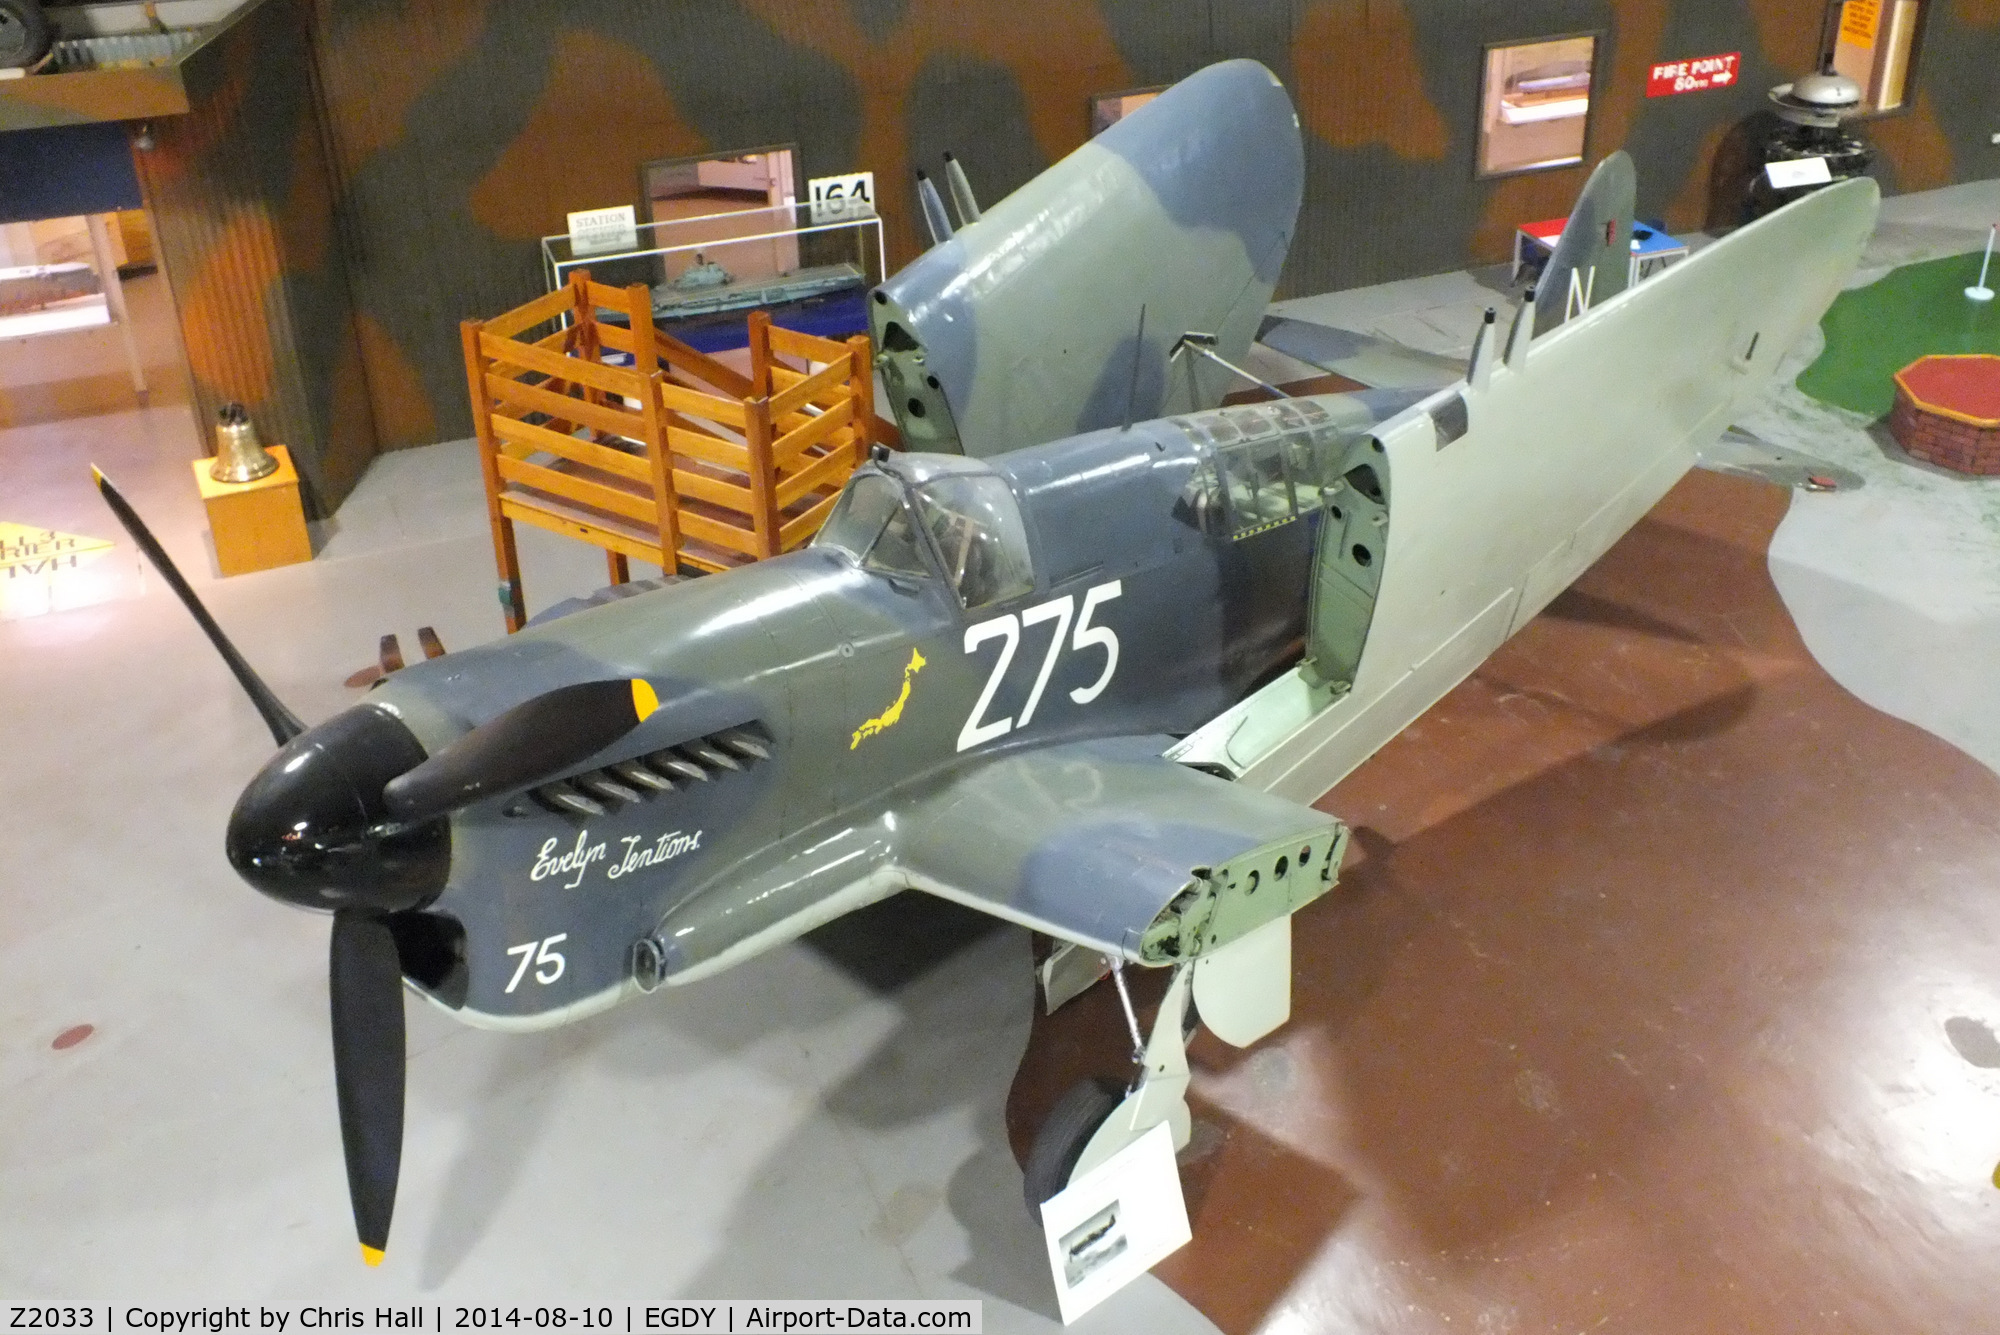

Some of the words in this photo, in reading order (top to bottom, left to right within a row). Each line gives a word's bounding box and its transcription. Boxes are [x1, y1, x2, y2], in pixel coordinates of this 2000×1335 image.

[1653, 63, 1689, 80] FIRE
[1691, 56, 1735, 75] POINT
[576, 212, 625, 228] STATION
[815, 180, 870, 214] 164
[1564, 266, 1596, 322] N
[957, 579, 1122, 752] 275
[530, 829, 606, 889] Evelyn
[504, 932, 568, 994] 75
